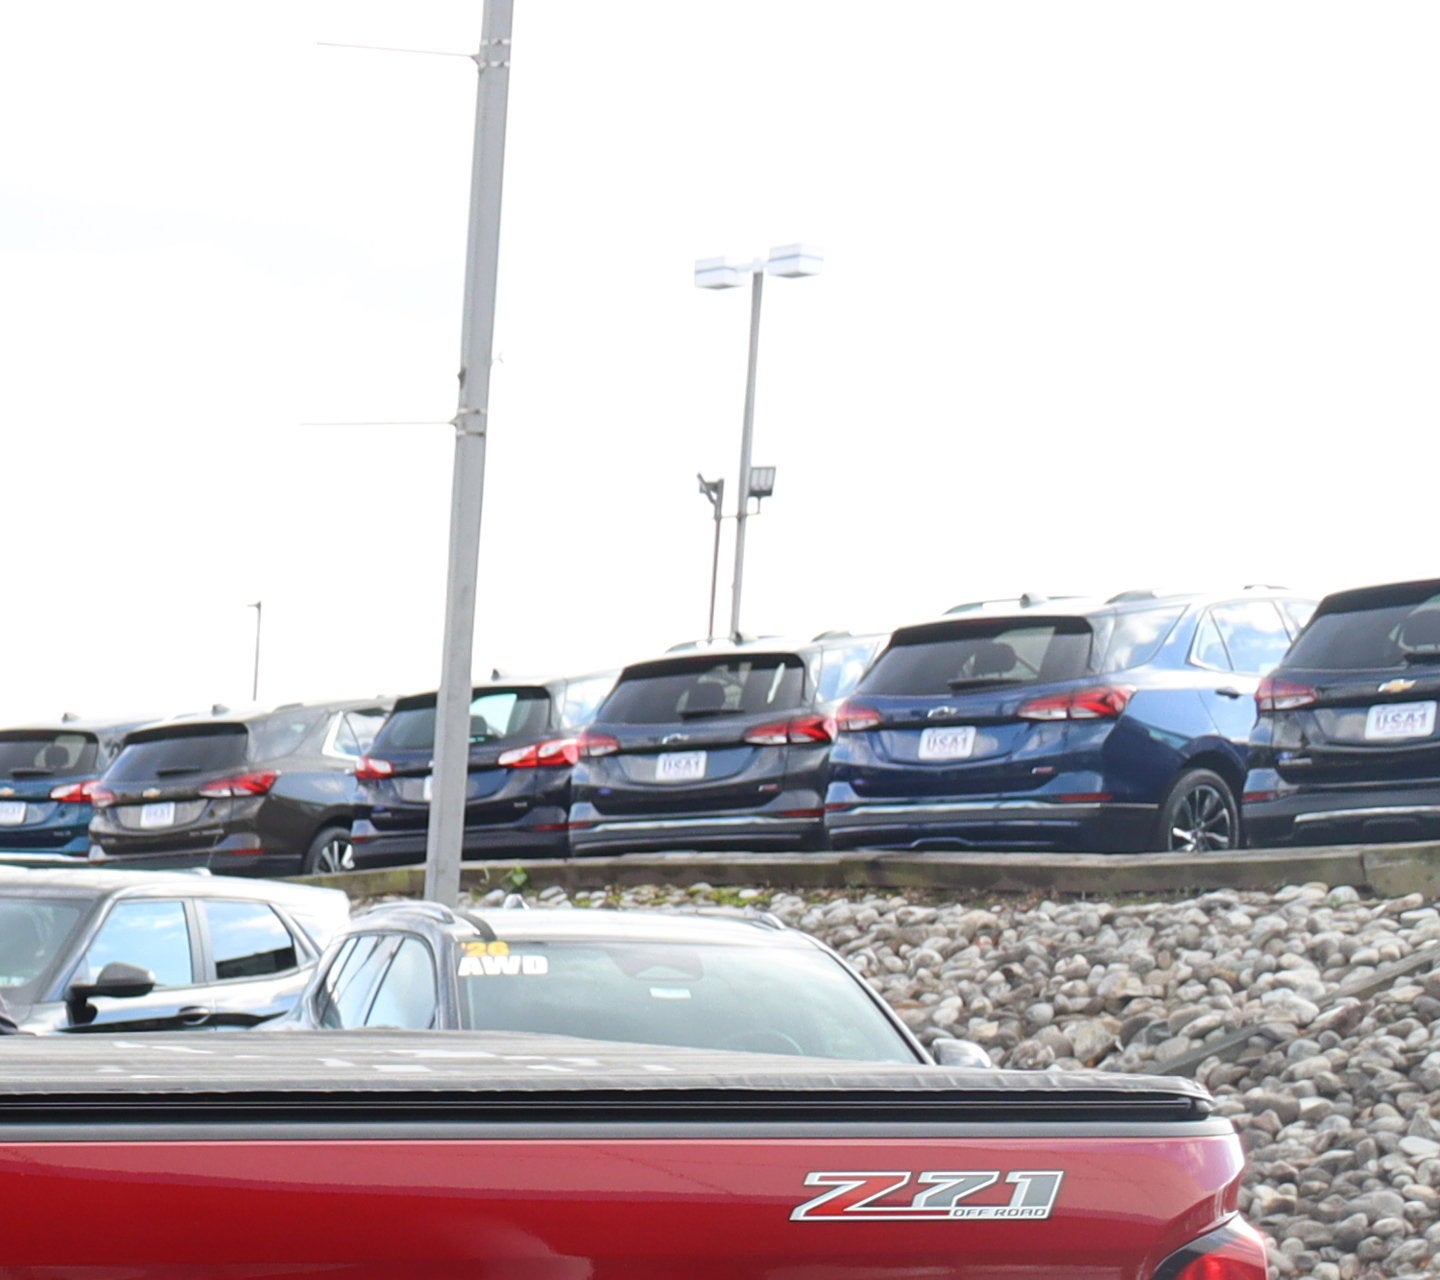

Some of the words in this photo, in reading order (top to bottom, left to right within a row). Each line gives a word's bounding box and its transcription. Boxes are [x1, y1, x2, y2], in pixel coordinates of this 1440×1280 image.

[458, 955, 549, 977] AWD
[788, 1170, 1064, 1221] Z71
[953, 1208, 988, 1217] OFF
[994, 1208, 1047, 1217] ROAD
